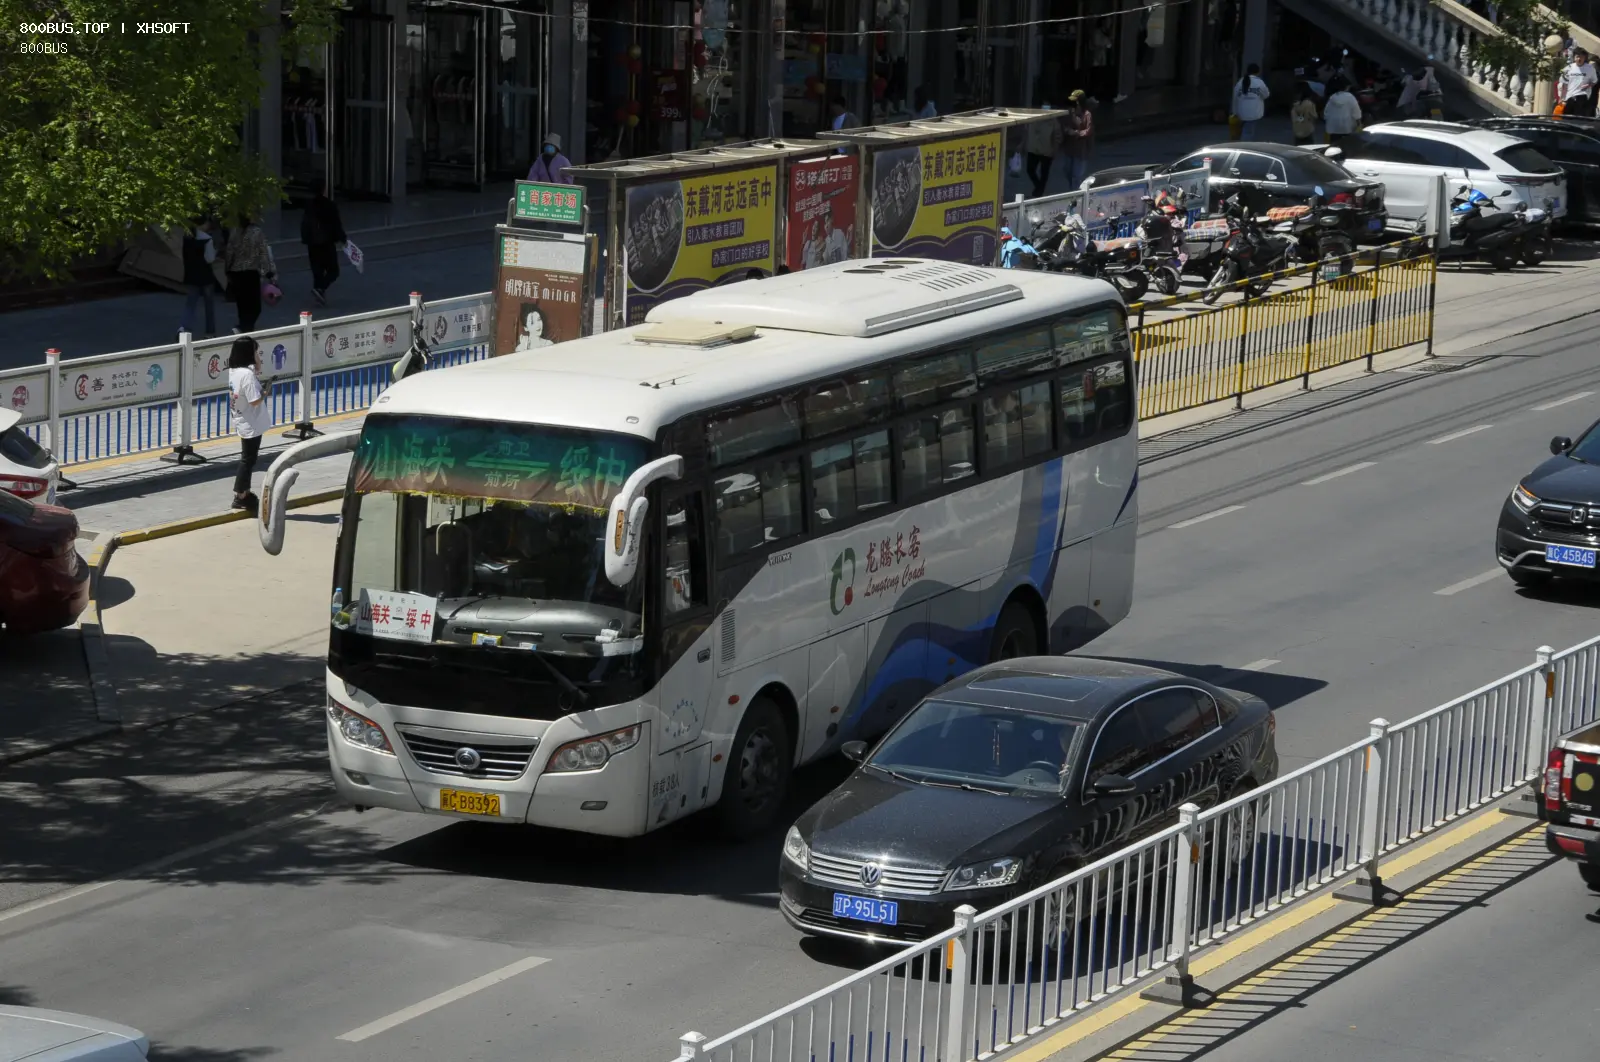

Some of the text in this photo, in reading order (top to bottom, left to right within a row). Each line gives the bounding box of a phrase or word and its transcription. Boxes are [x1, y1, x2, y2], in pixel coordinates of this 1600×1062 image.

[923, 142, 997, 181] 东戴河志远高中
[530, 189, 577, 209] 肖家市场
[685, 175, 772, 219] 东戴河志远高中
[686, 220, 744, 244] 引入衡水教育团队
[712, 243, 770, 265] 办家门口的好学校
[504, 278, 541, 299] 明牌珠宝
[373, 433, 456, 486] 山海关
[553, 445, 627, 501] 绥中
[483, 470, 521, 490] 前所
[865, 524, 921, 574] 龙腾长客
[864, 558, 926, 599] Longteng Coach
